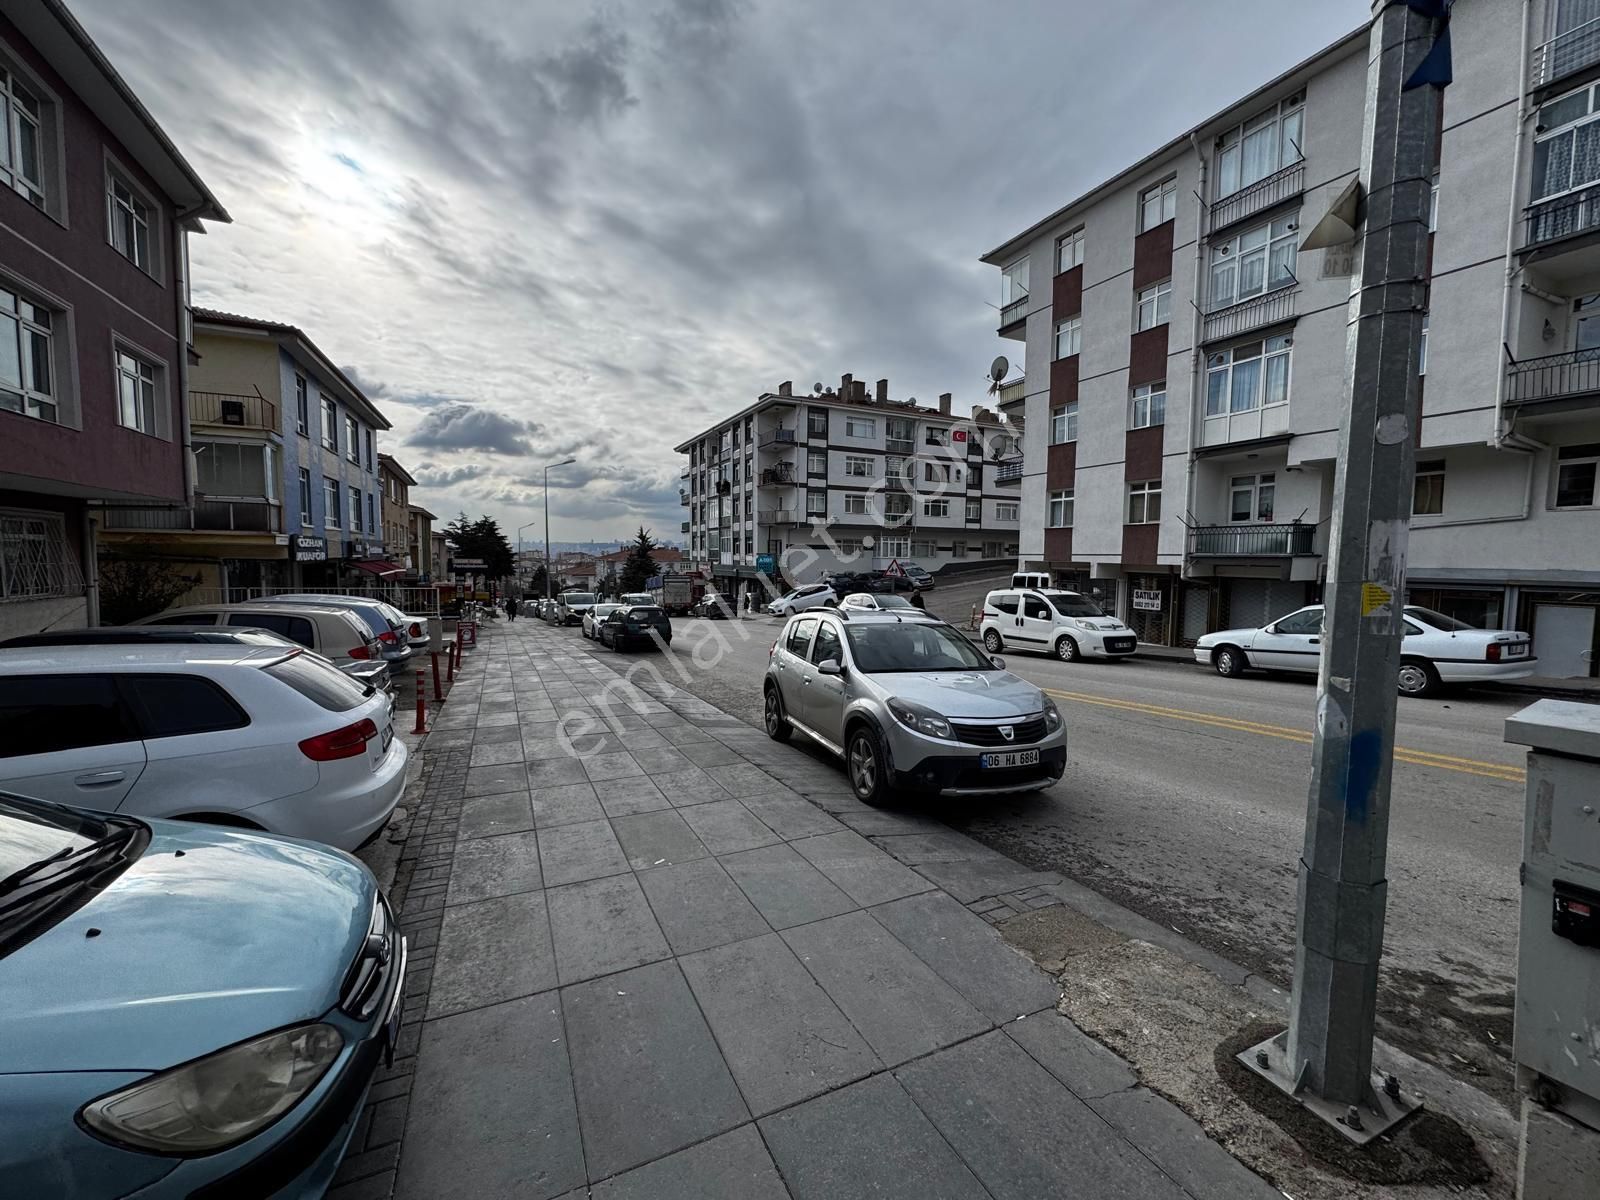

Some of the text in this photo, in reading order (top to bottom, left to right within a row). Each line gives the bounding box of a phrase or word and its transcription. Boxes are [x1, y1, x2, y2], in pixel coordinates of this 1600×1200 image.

[298, 535, 323, 548] ÖZHAN
[1135, 591, 1160, 601] SATILIK
[988, 755, 1000, 767] 06
[1005, 754, 1016, 766] HA
[1020, 751, 1038, 765] 6884
